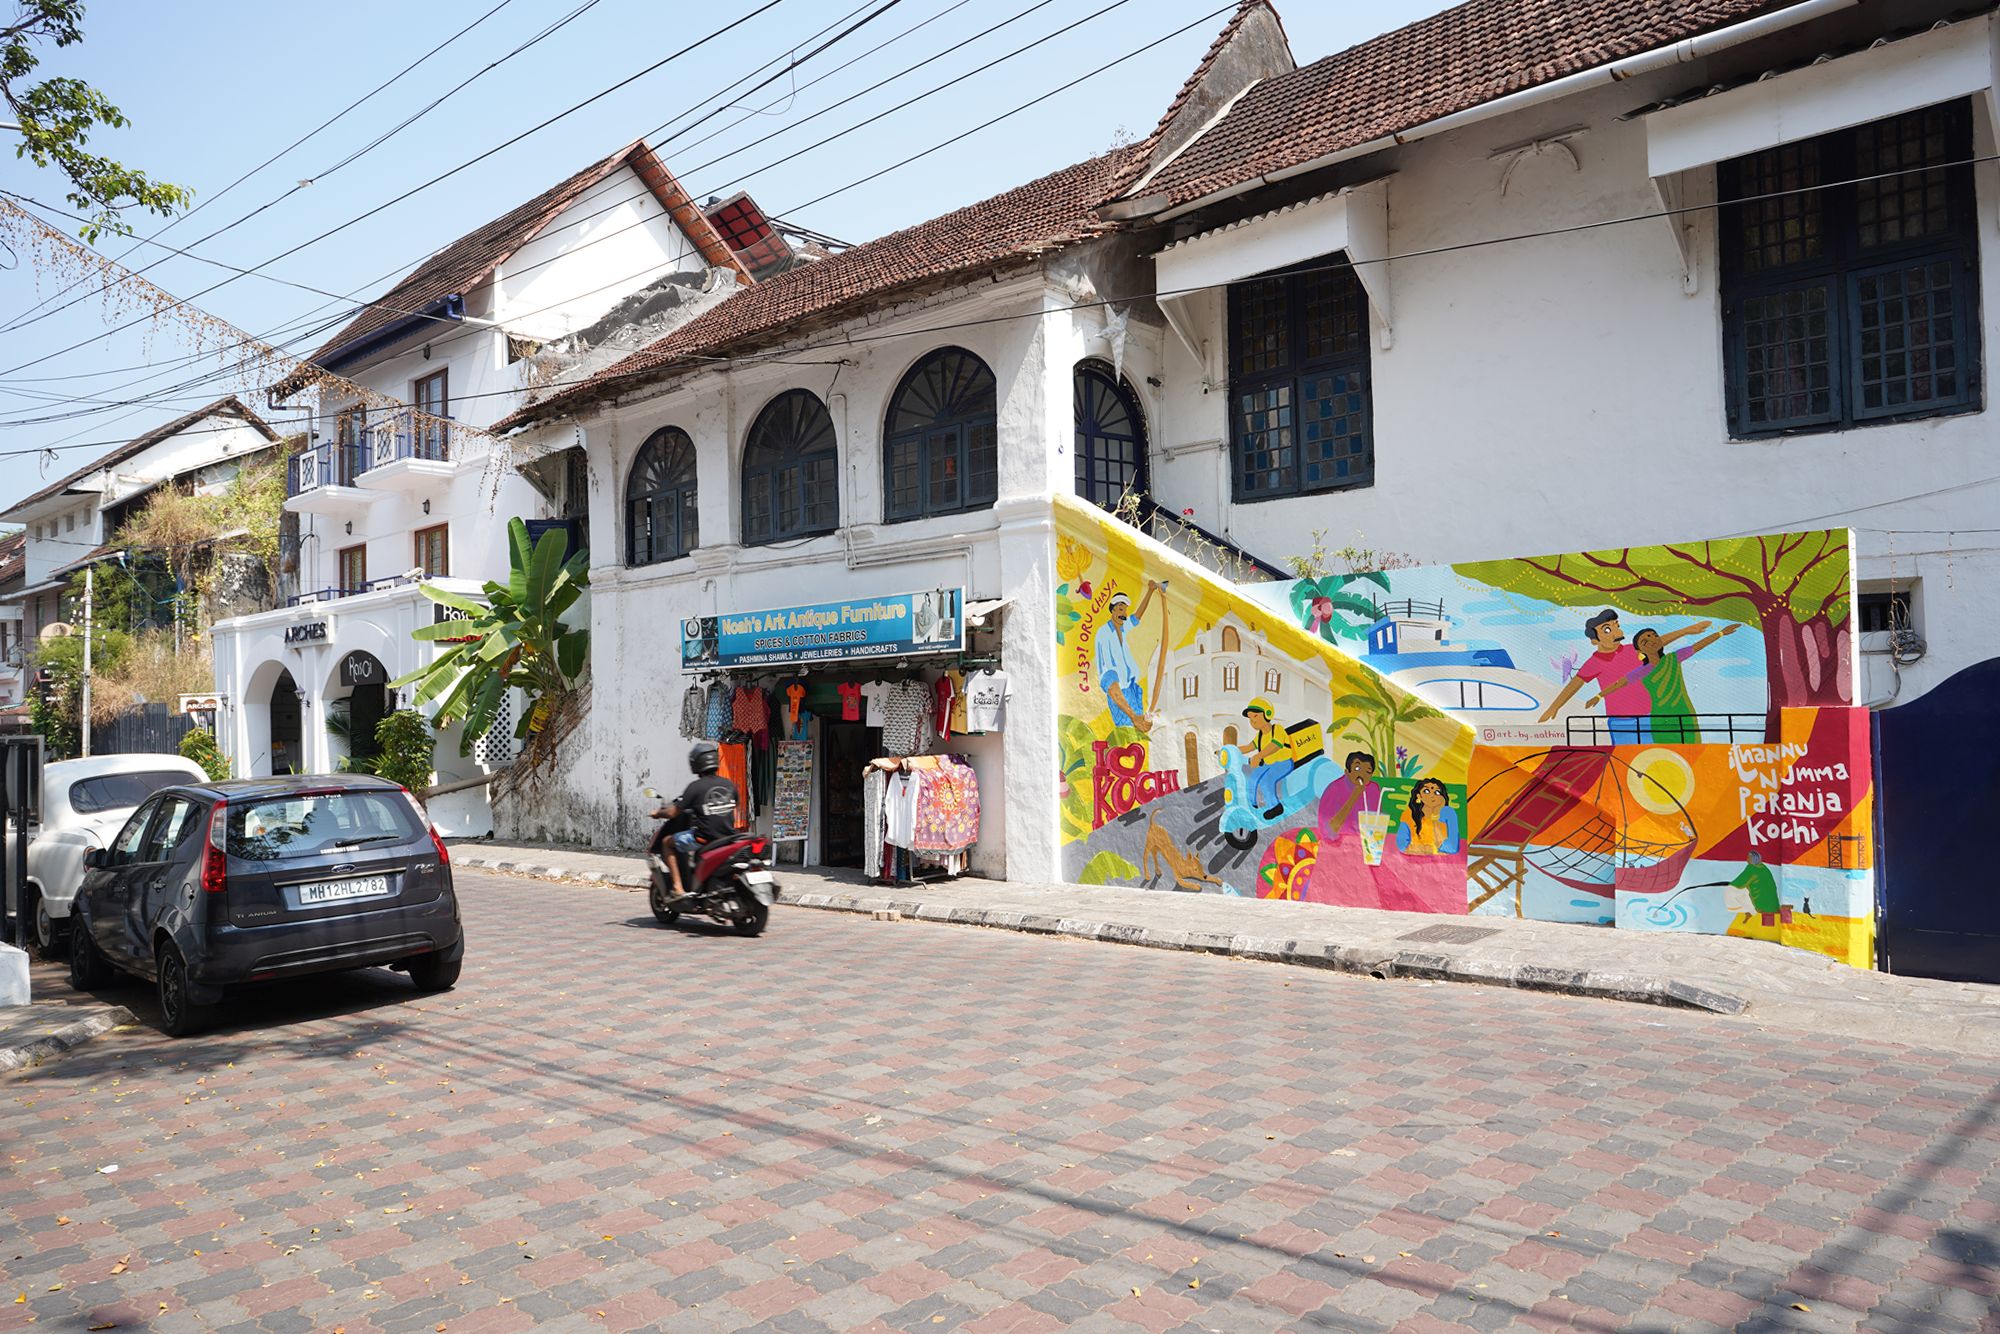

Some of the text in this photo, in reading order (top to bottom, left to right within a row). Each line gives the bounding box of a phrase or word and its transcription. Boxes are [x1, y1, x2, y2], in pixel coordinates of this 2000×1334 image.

[722, 602, 906, 635] Noah's Ark Antique Furniture
[1080, 579, 1118, 642] ORU CHAYA
[284, 622, 327, 643] ARCHES
[755, 630, 867, 650] SPICES & COTTON FABRICS
[739, 644, 898, 663] PASHMINA SHAWLS JEWELLERIES HANDICRAFTS
[1092, 740, 1110, 776] I
[1092, 769, 1180, 831] KOCHI
[1746, 815, 1819, 846] Kochi
[236, 910, 277, 919] TIANIUM
